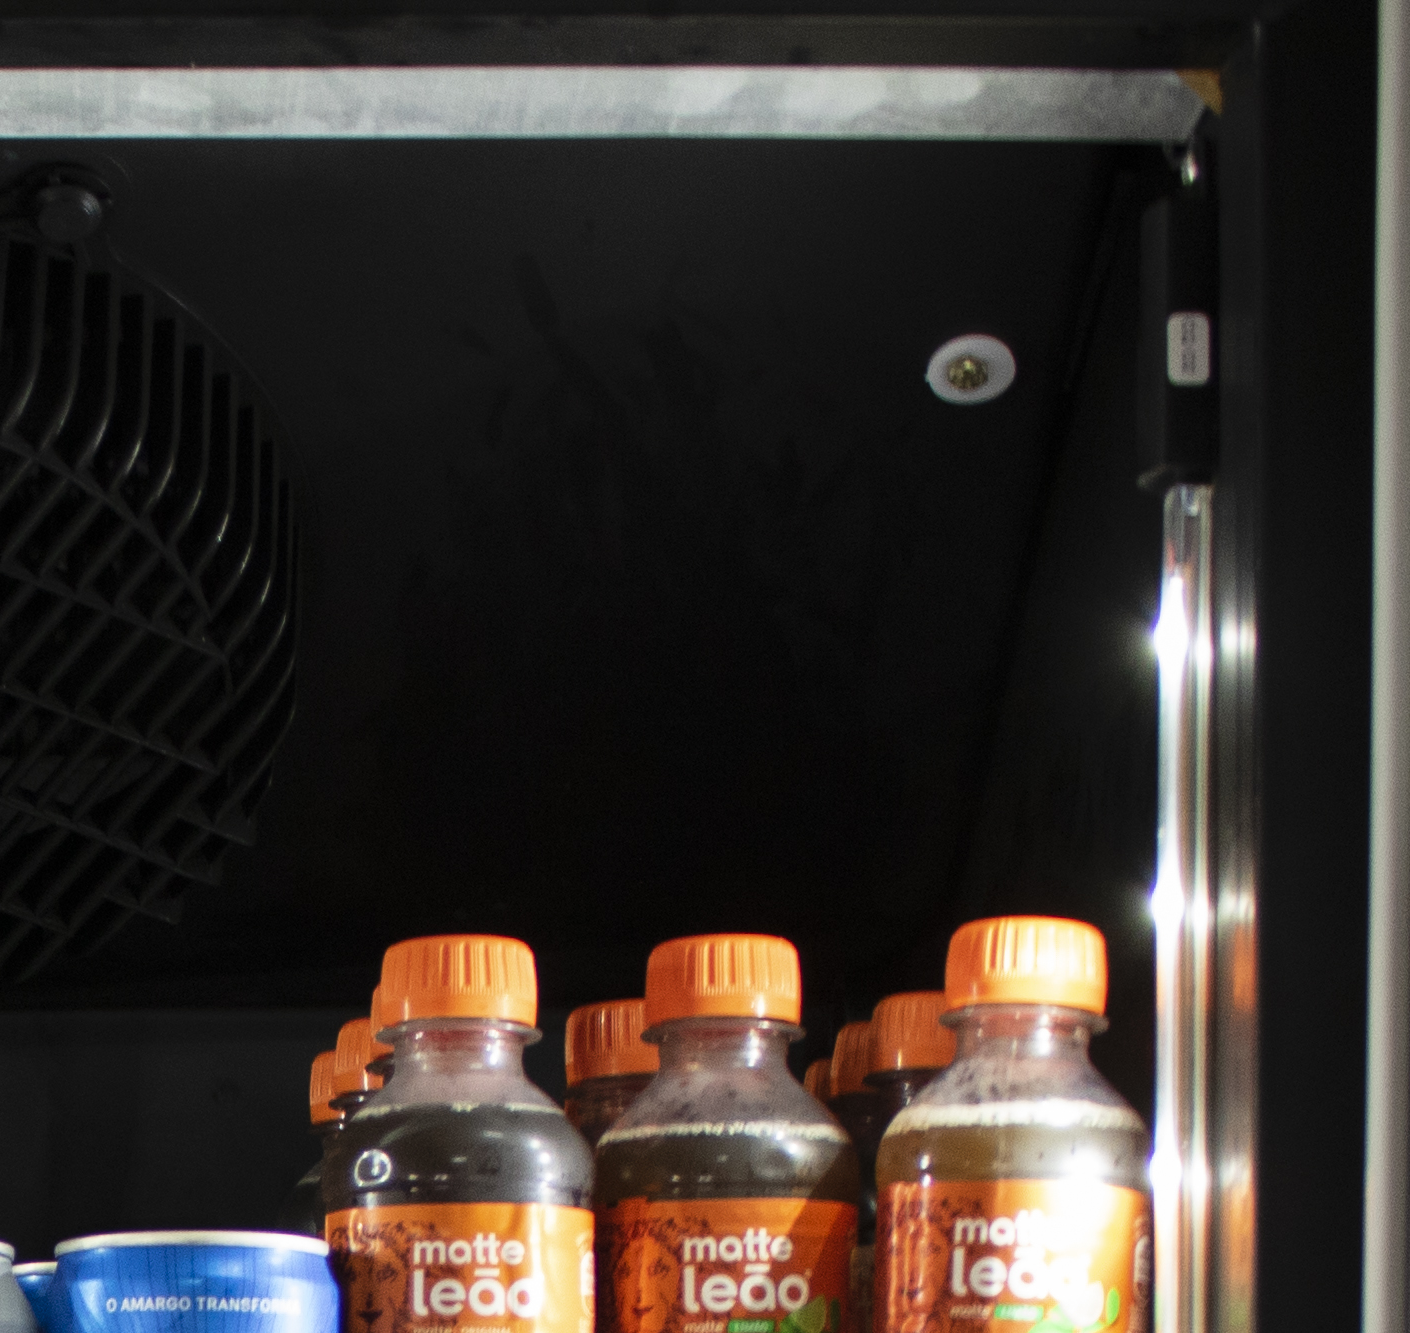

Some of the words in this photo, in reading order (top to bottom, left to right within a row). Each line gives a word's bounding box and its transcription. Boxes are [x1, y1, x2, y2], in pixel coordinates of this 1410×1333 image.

[413, 1232, 525, 1265] matte
[683, 1227, 793, 1263] matte
[120, 1296, 191, 1312] AMARGO
[413, 1267, 544, 1318] leão
[683, 1263, 809, 1314] leão
